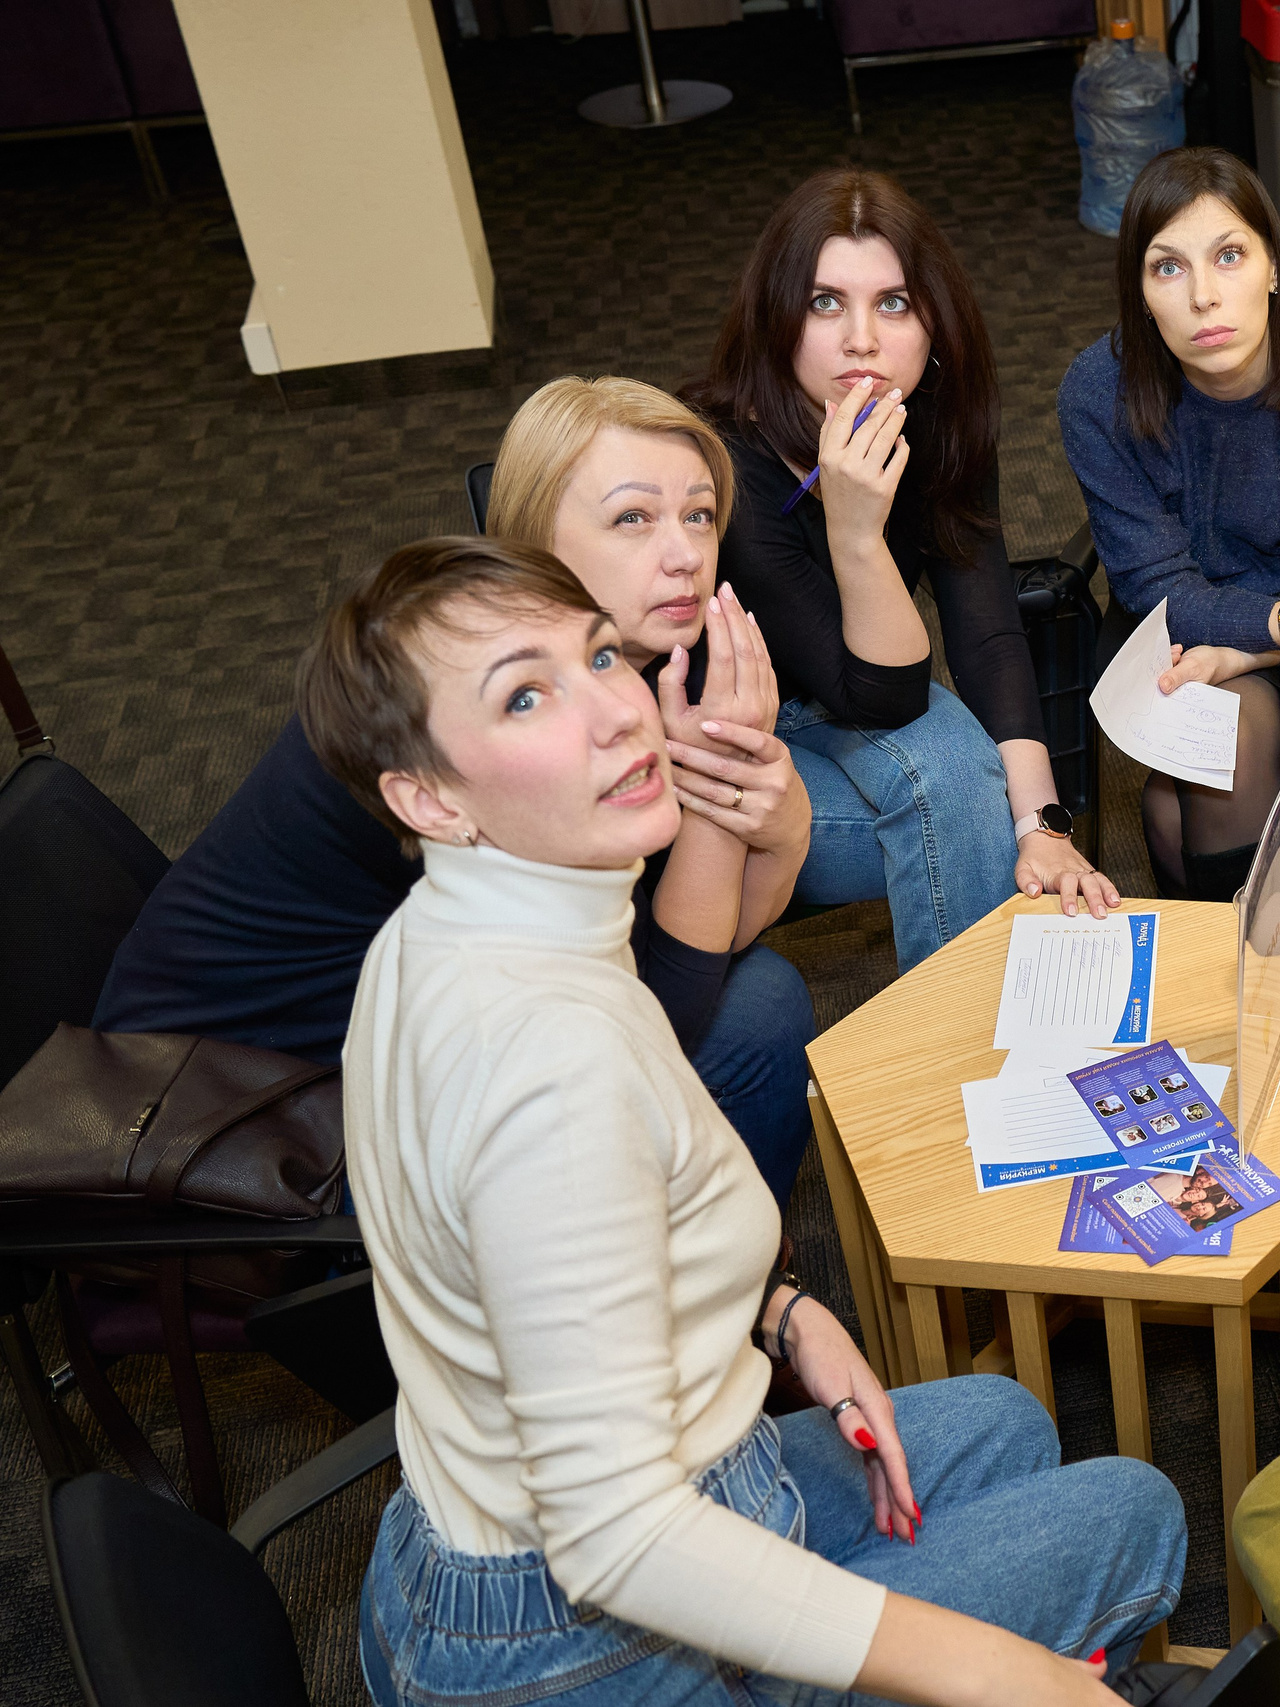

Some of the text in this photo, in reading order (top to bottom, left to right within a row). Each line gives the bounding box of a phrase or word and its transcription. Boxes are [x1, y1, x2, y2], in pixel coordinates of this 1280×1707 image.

[1138, 922, 1149, 941] РАУНД
[1151, 1130, 1206, 1154] НАШИ ПРОЕКТЫ
[999, 1166, 1045, 1180] МЕРКУРИЯ
